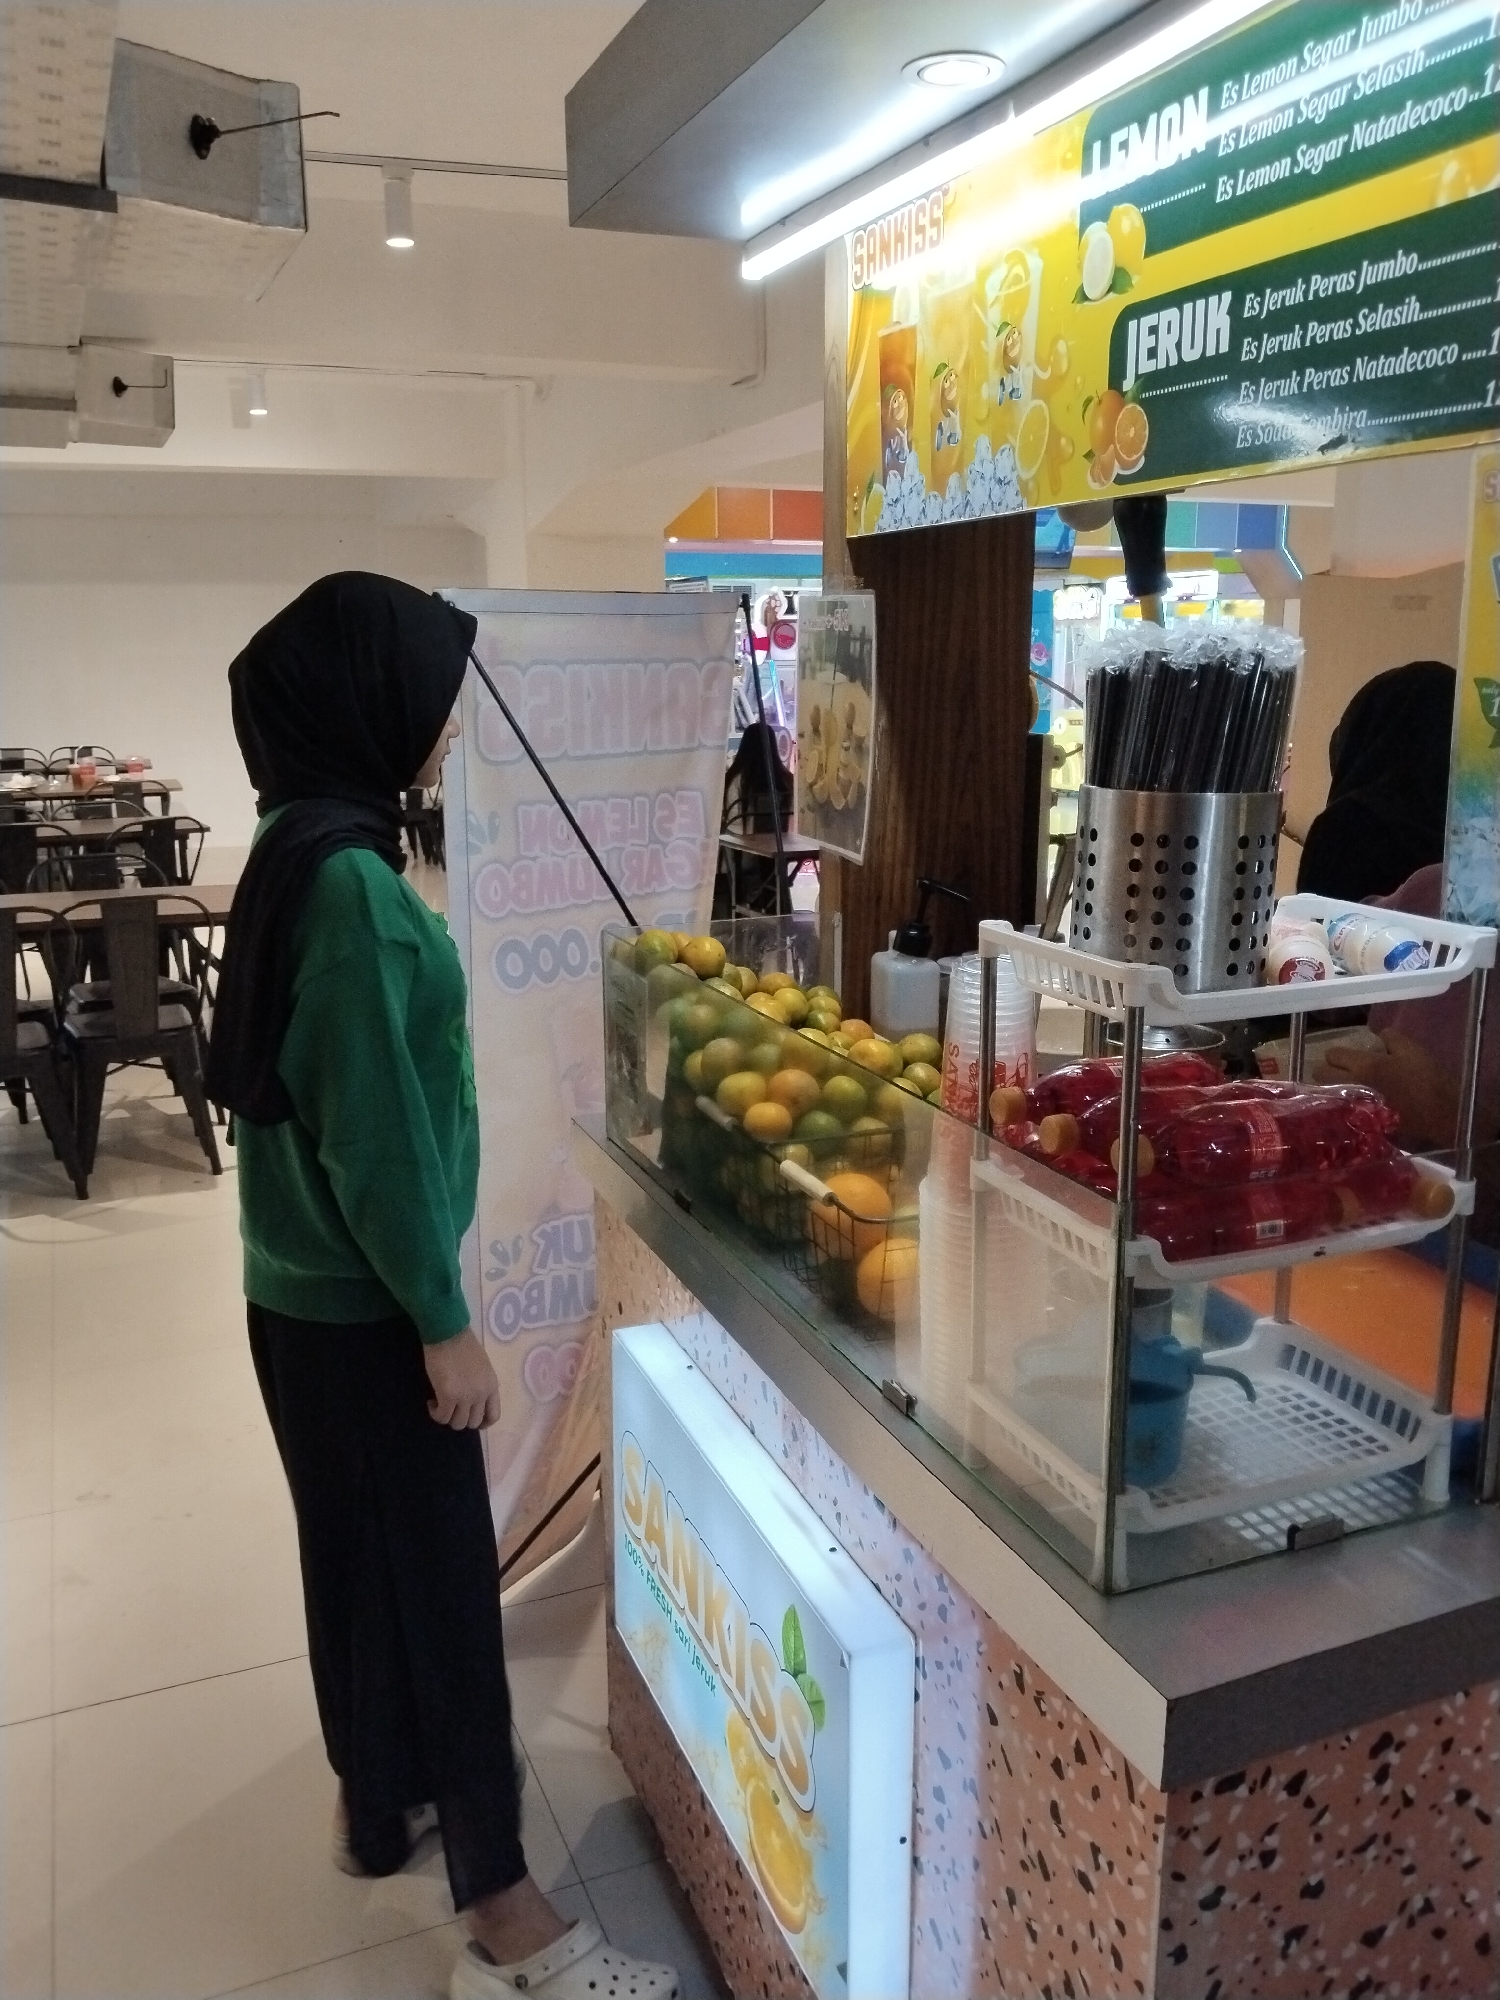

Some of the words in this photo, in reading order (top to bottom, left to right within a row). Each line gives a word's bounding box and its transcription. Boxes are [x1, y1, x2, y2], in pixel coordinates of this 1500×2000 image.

[1221, 81, 1238, 109] Es
[1241, 56, 1298, 100] Lemon
[1301, 28, 1356, 72] Segar
[1091, 86, 1208, 197] LEMON
[1216, 175, 1233, 203] Es
[1236, 156, 1291, 195] Lemon
[1294, 134, 1348, 174] Segar
[1350, 87, 1467, 152] Natadecoco
[1218, 132, 1235, 157] Es
[1239, 107, 1295, 149] Lemon
[1297, 82, 1353, 124] Segar
[853, 192, 943, 286] SANKISS
[1243, 293, 1260, 318] Es
[1261, 279, 1306, 319] Jeruk
[1308, 270, 1356, 300] Peras
[1123, 291, 1232, 391] JERUK
[1239, 382, 1255, 404] Es
[1257, 370, 1300, 405] Jeruk
[1303, 366, 1350, 392] Peras
[1353, 343, 1458, 383] Natadecoco
[1241, 338, 1258, 361] Es
[1258, 325, 1303, 363] Jeruk
[1305, 318, 1353, 347] Peras
[1236, 425, 1252, 448] Es
[1301, 406, 1367, 438] embira
[621, 1437, 813, 1806] SANKISS
[624, 1534, 644, 1577] 100%
[646, 1570, 673, 1623] FRESH
[674, 1619, 691, 1652] sari
[691, 1645, 717, 1697] jeruk
